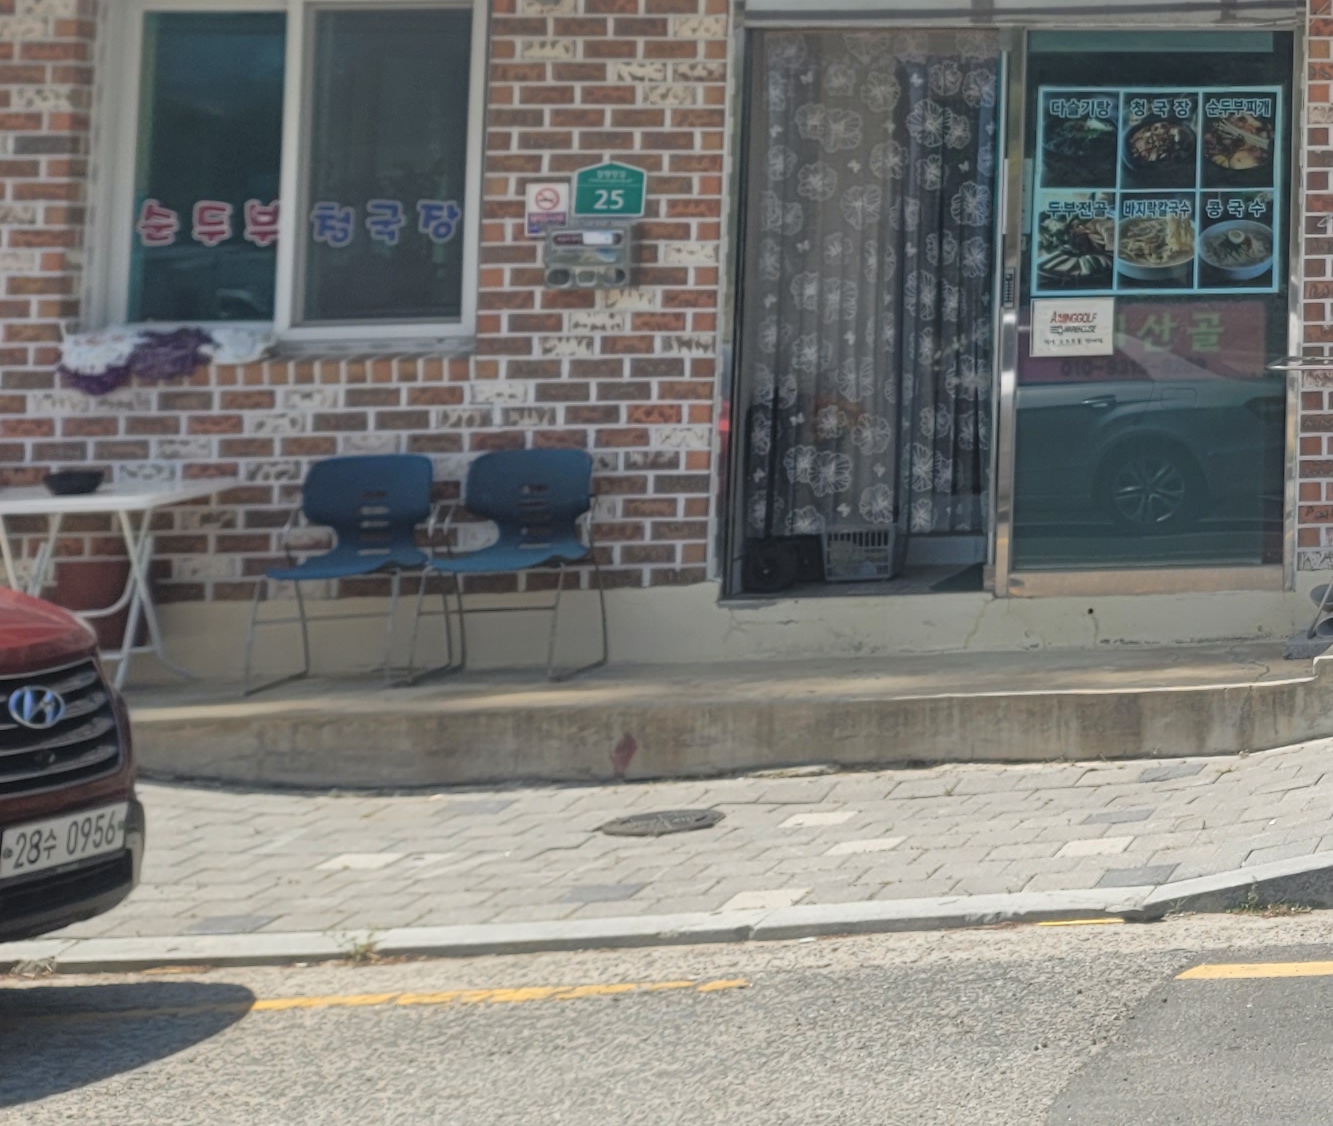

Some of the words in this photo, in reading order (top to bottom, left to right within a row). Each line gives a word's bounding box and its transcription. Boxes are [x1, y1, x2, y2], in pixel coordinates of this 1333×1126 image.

[1051, 98, 1112, 118] 다슬기탕
[1205, 98, 1272, 118] 순두부찌개
[593, 190, 625, 210] 25
[1047, 201, 1109, 219] 두부전골
[1123, 199, 1192, 218] 바지락칼국수
[13, 828, 57, 869] 28수
[66, 810, 116, 855] 0956
